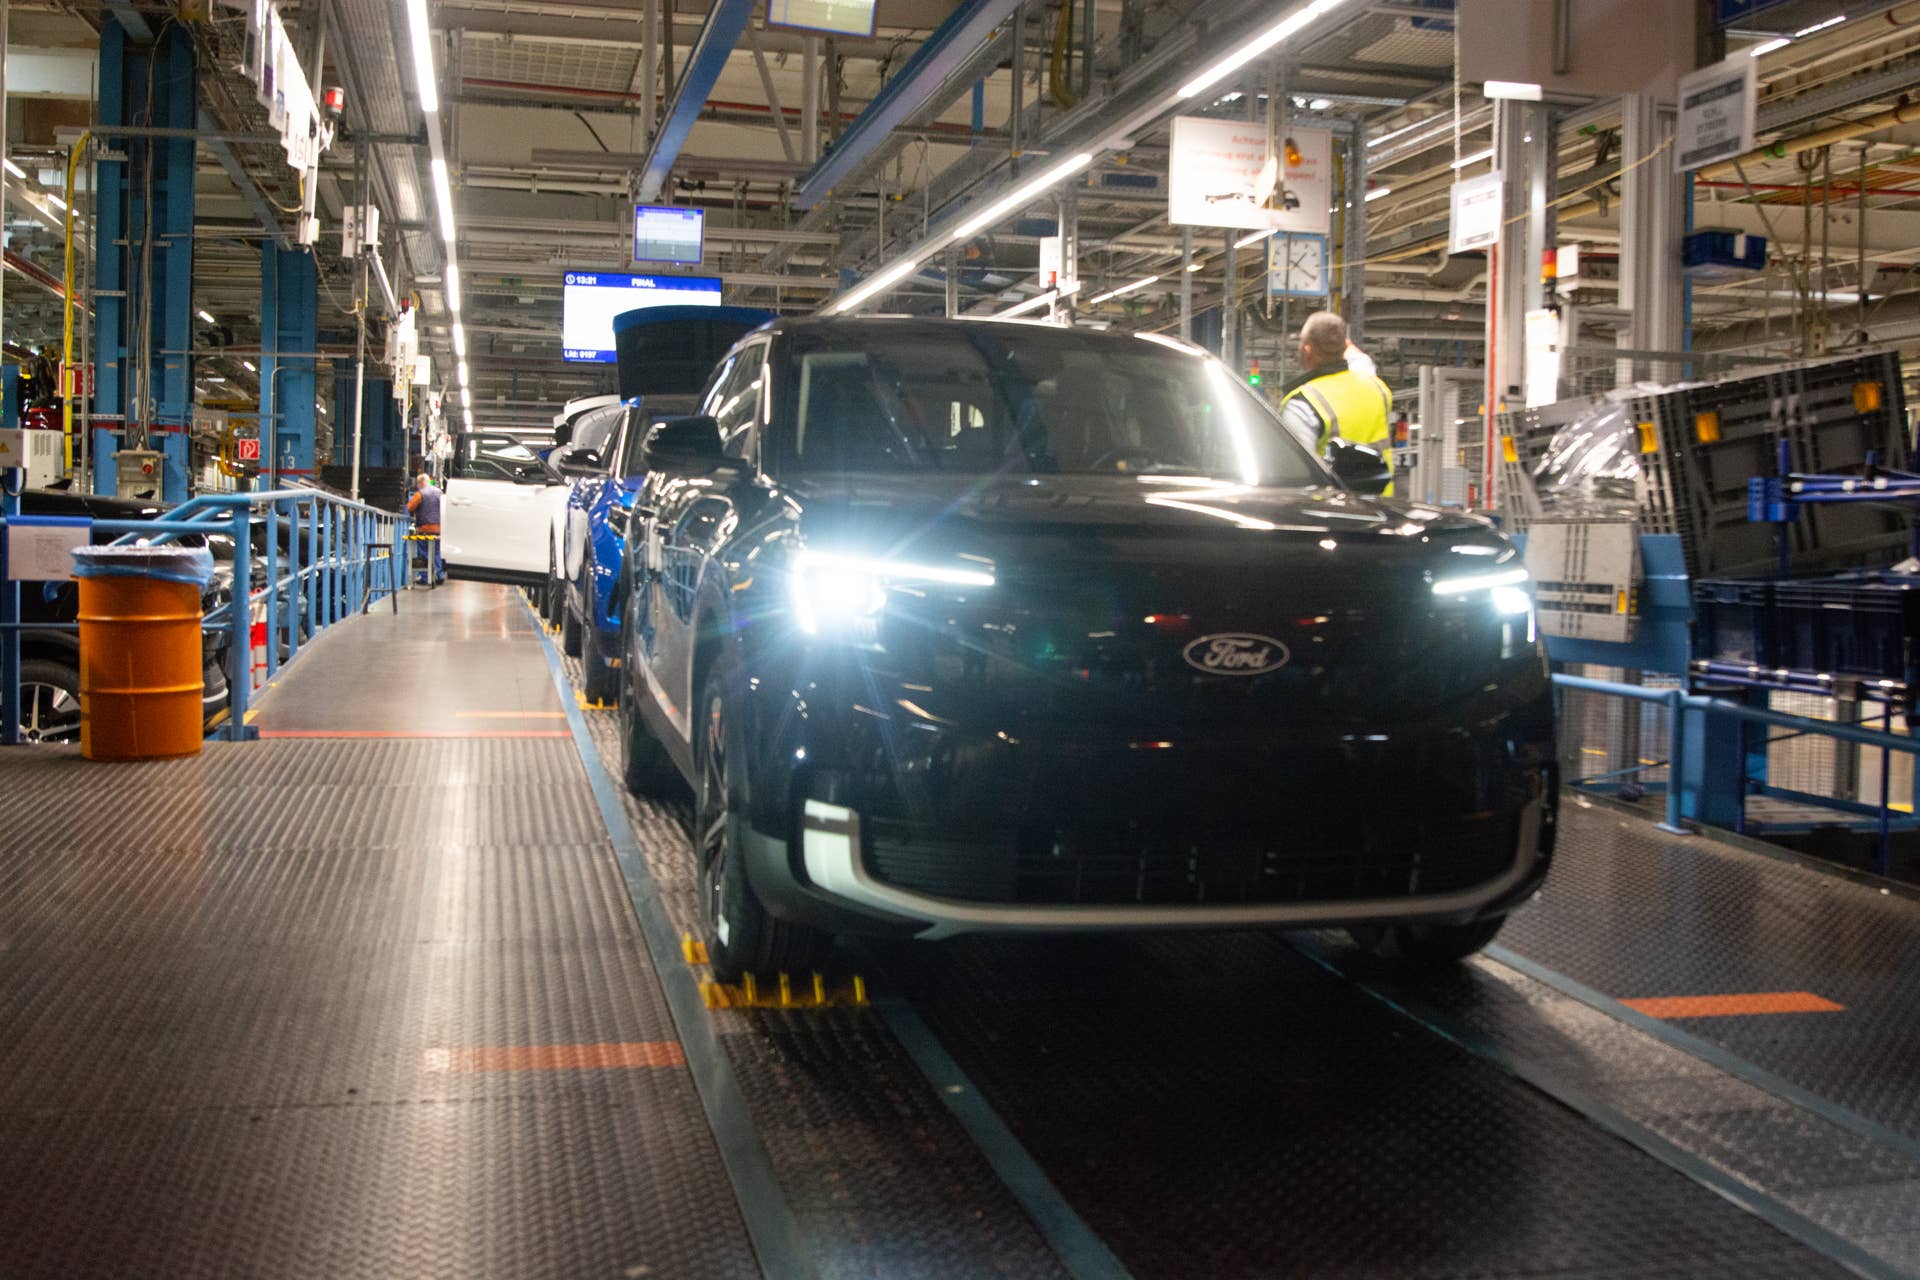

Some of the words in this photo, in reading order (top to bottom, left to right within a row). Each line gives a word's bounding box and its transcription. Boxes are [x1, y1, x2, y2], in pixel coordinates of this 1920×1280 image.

[631, 277, 657, 288] FINAL
[279, 455, 296, 470] 13
[1203, 638, 1271, 669] Ford
